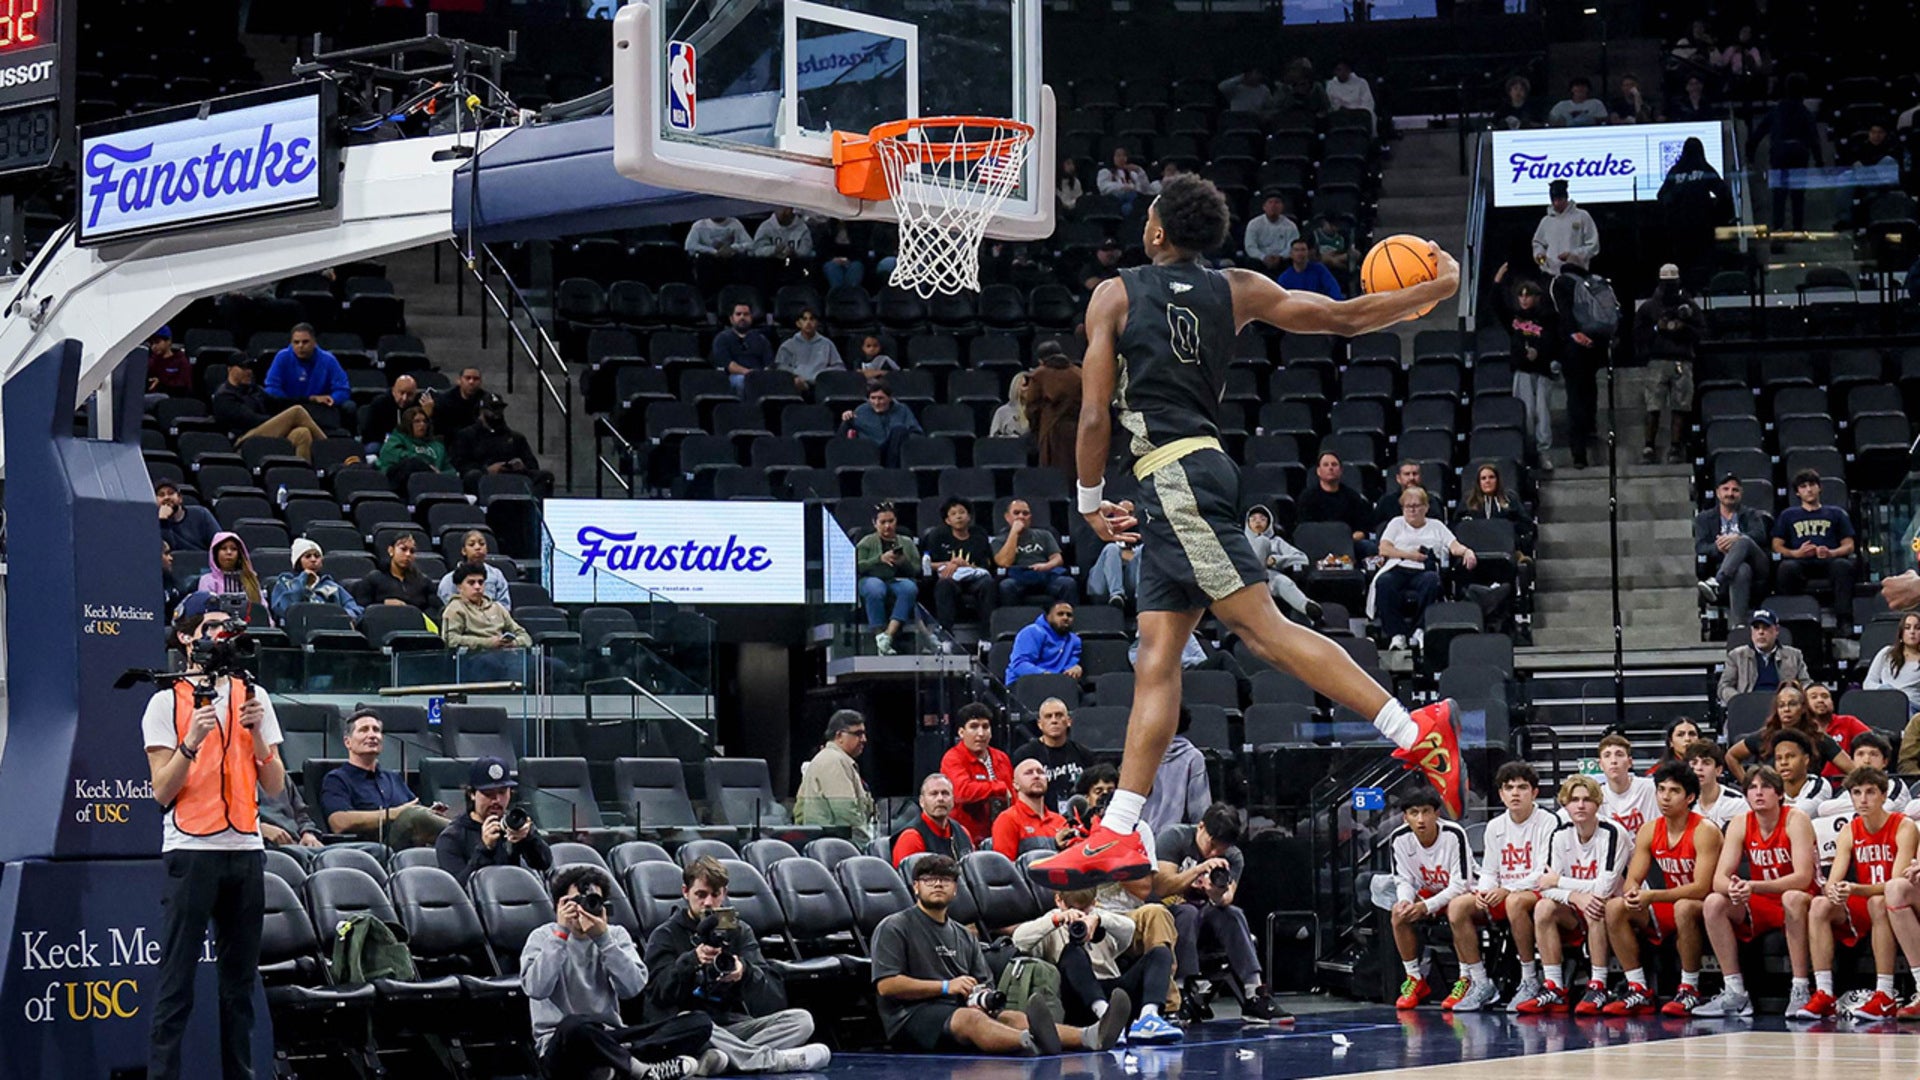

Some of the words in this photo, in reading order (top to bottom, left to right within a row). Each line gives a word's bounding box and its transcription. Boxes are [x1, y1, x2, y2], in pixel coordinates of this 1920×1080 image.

[86, 123, 318, 228] Fanstake
[1509, 153, 1636, 183] Fanstake
[1793, 519, 1831, 538] PITT
[577, 525, 773, 576] Fanstake
[84, 604, 108, 618] Keck
[110, 605, 154, 620] Medicine
[84, 620, 96, 634] of
[97, 621, 120, 635] USC
[75, 779, 111, 798] Keck
[1355, 795, 1366, 808] 8
[76, 802, 93, 823] of
[94, 803, 129, 823] USC
[21, 929, 101, 970] Keck
[24, 981, 60, 1022] of
[64, 979, 139, 1020] USC
